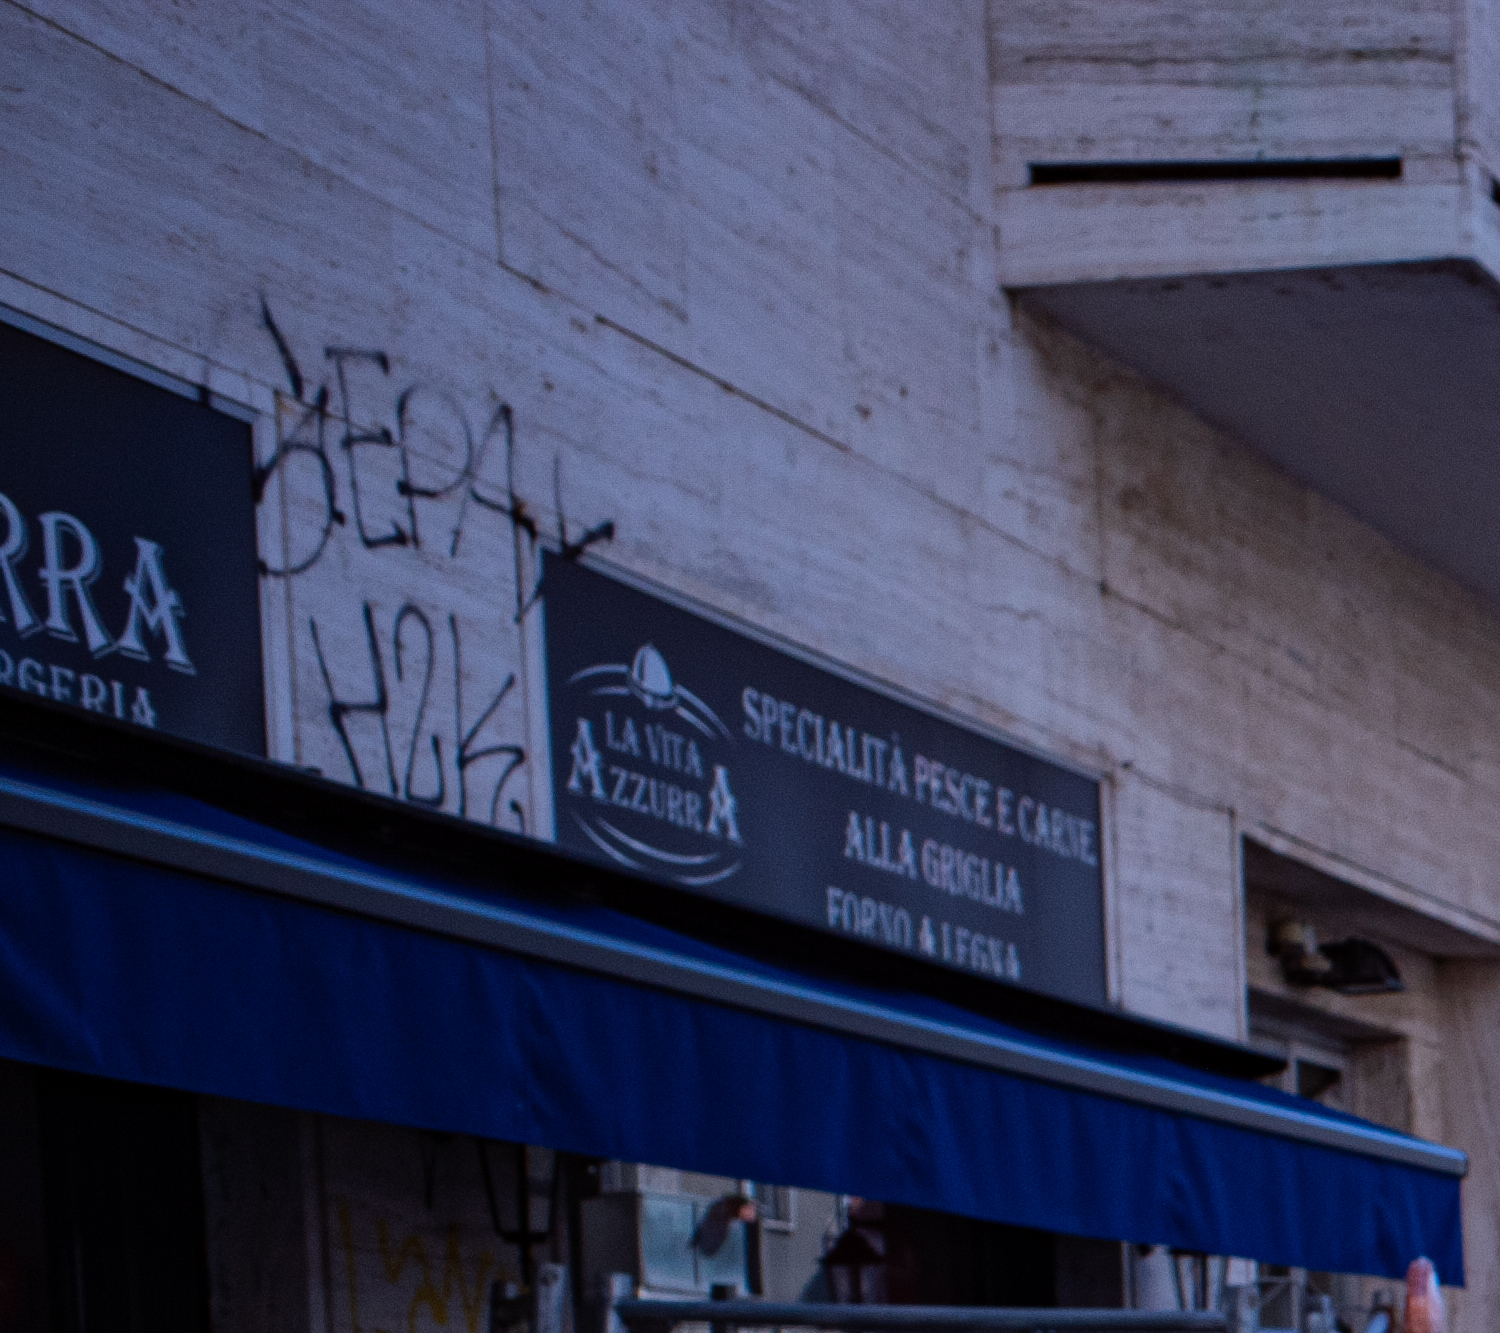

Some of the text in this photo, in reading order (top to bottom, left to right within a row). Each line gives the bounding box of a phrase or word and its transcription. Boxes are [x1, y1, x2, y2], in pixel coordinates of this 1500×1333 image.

[566, 716, 744, 847] AZZURRA
[604, 709, 705, 780] LA VITA
[844, 809, 1024, 915] ALLA GRIGLIA
[913, 752, 992, 828] PESCE
[996, 786, 1015, 836] E
[1016, 795, 1098, 868] CARNE
[825, 884, 913, 951] FORNO
[918, 915, 937, 956] A
